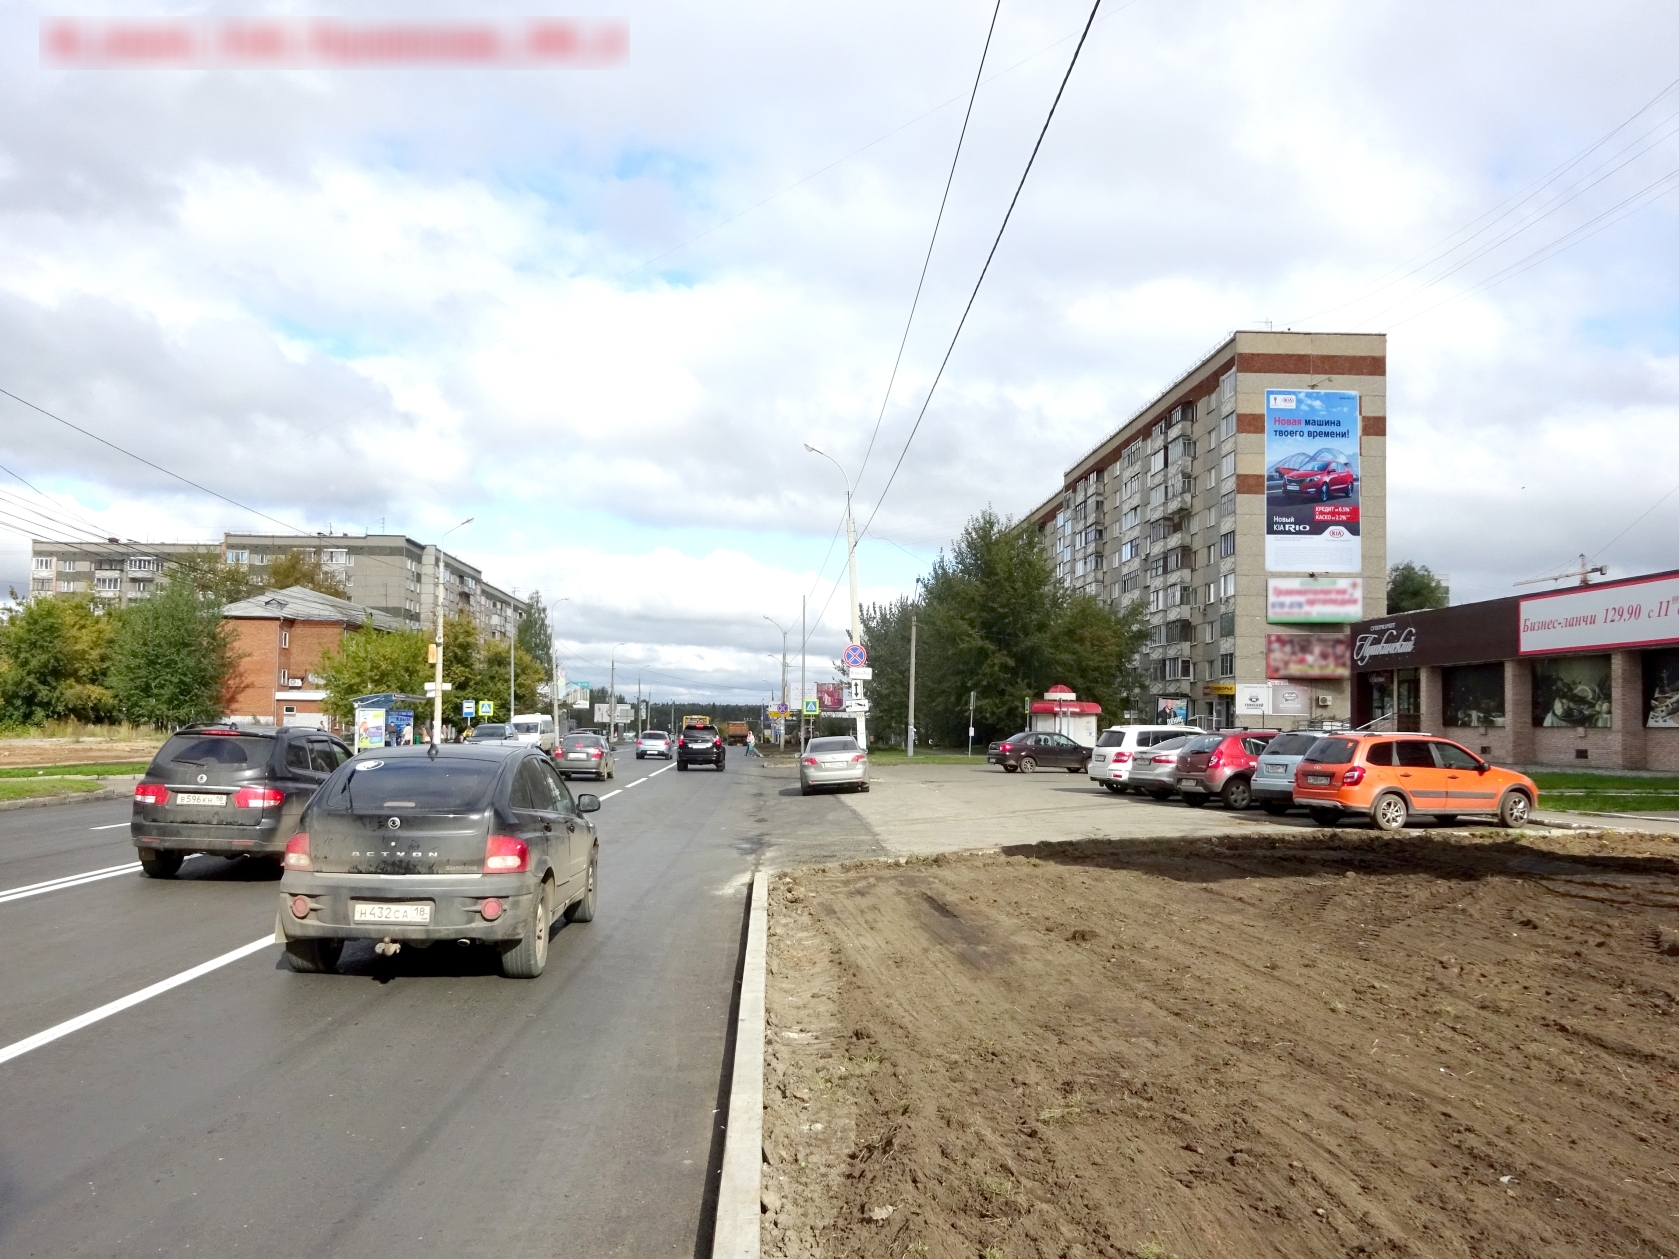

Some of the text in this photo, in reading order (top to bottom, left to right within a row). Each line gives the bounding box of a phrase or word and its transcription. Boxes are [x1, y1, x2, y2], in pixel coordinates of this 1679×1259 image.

[1273, 417, 1342, 427] Новая машина
[1273, 429, 1350, 439] твоего времени!
[1285, 524, 1310, 532] RIO
[1522, 613, 1597, 633] Бизнес-ланчи
[1647, 608, 1654, 619] с
[413, 907, 425, 916] 18
